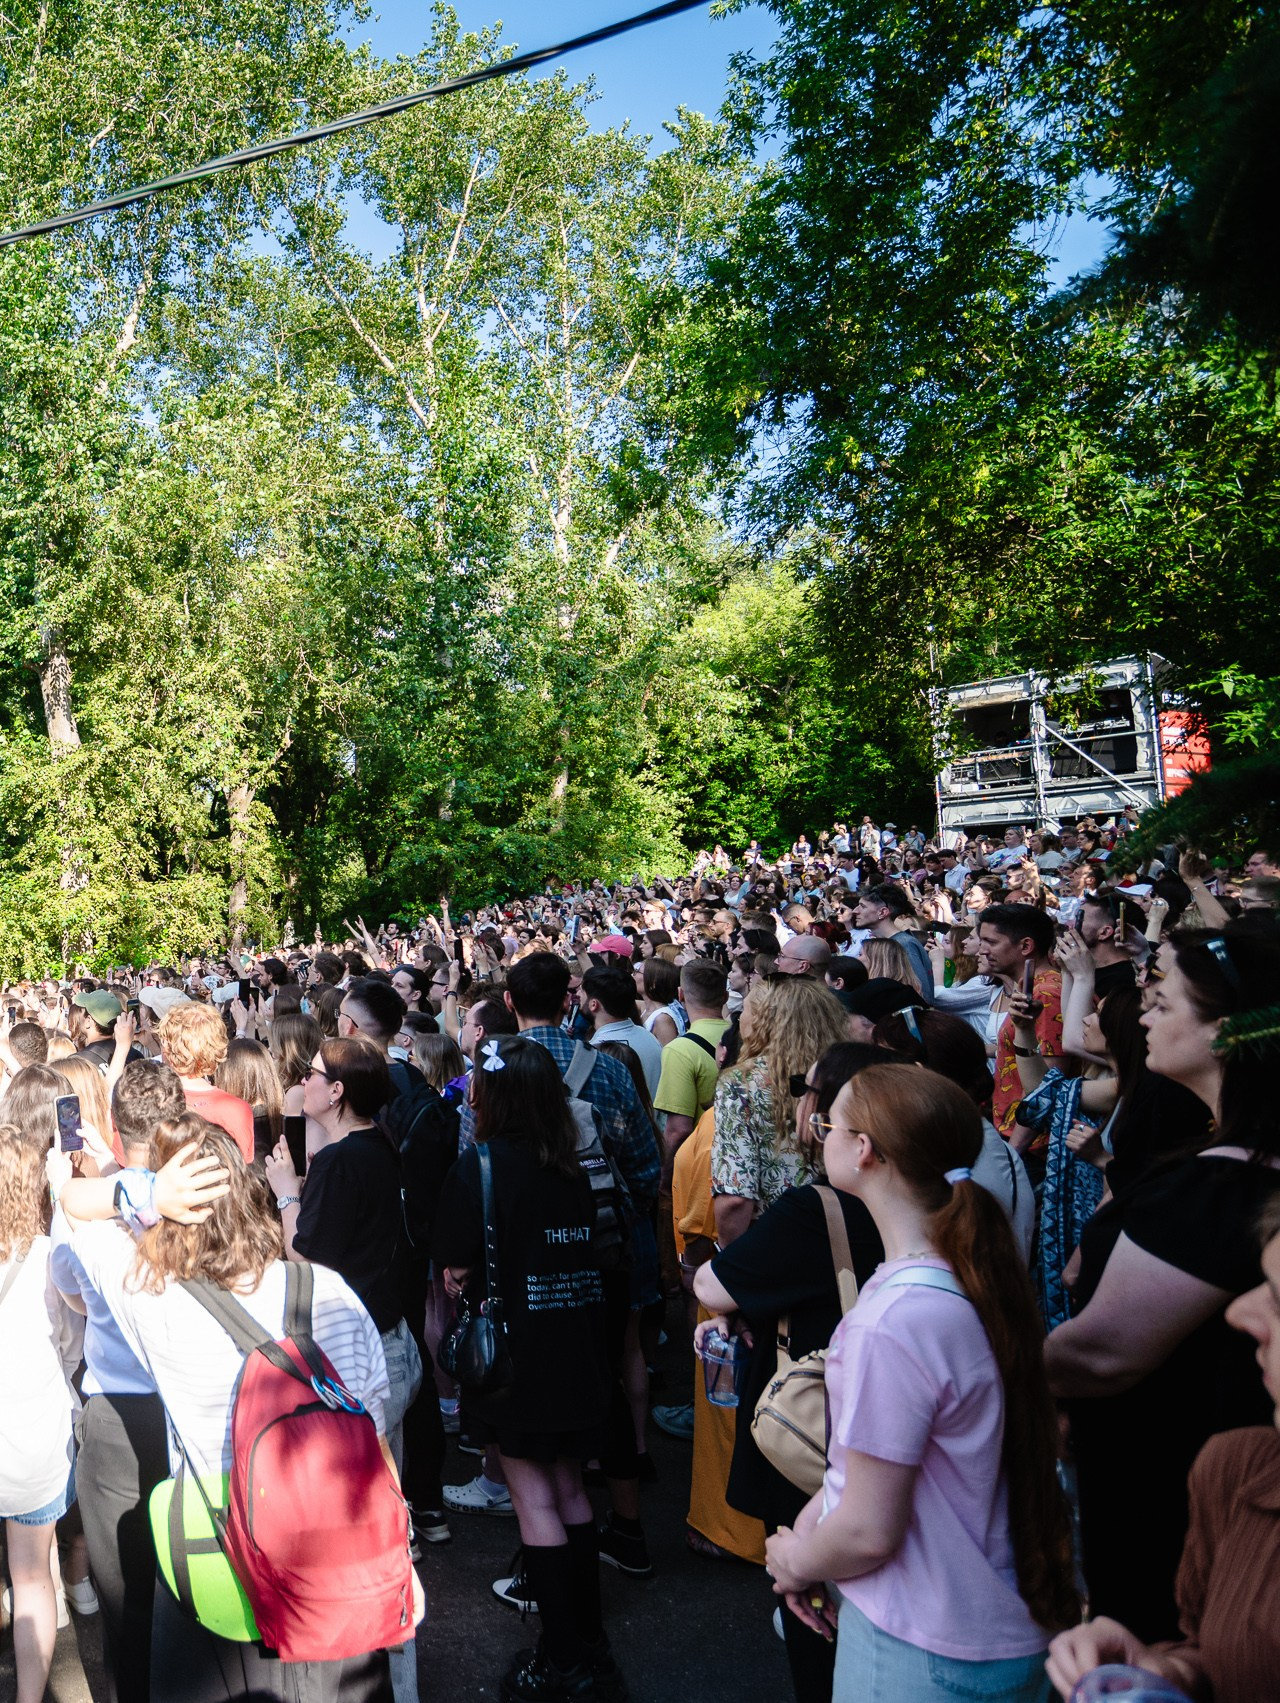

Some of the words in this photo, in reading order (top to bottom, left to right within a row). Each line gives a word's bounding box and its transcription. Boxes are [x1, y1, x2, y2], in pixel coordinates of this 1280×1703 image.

[559, 1272, 570, 1280] for
[552, 1281, 571, 1290] can't
[527, 1293, 541, 1301] did
[542, 1292, 550, 1300] to
[450, 1502, 484, 1512] crocs
